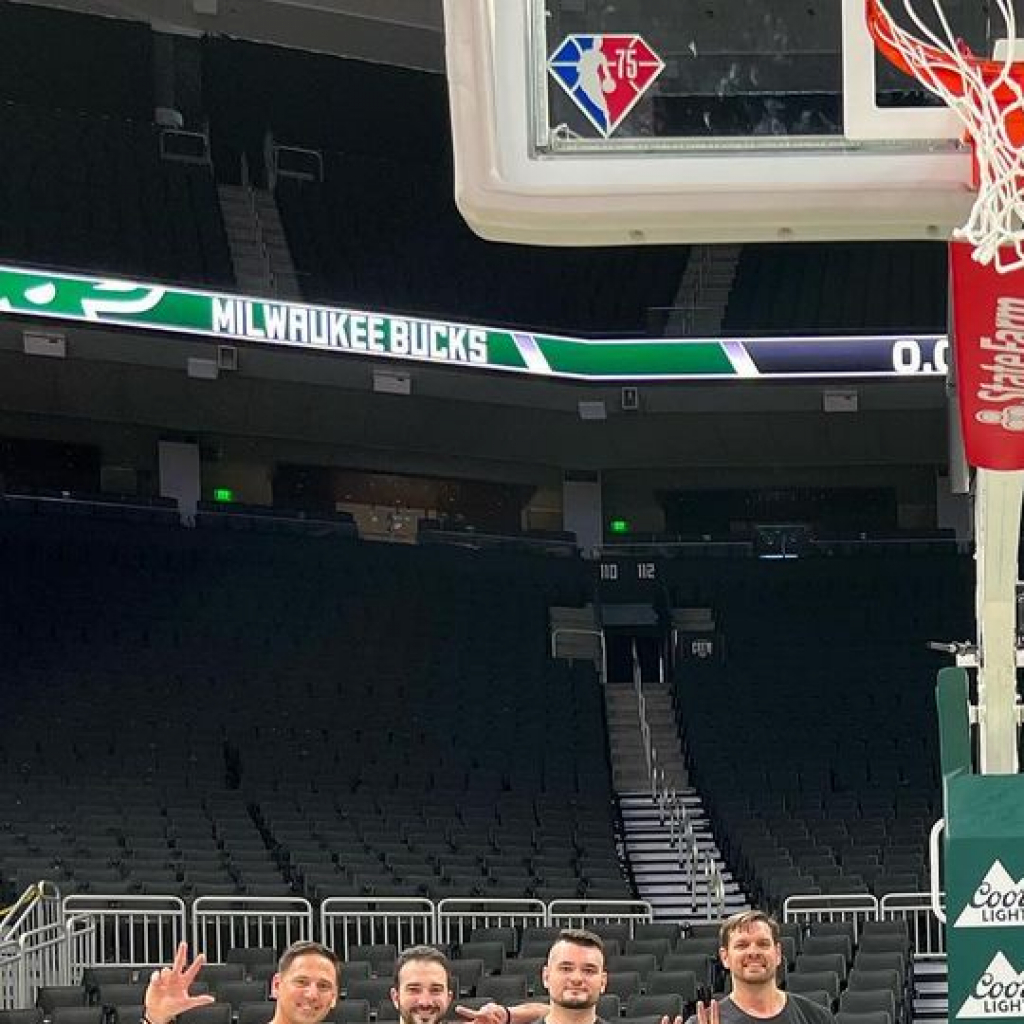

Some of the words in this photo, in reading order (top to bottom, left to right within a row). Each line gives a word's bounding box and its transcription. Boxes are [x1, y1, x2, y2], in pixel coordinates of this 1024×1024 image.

[615, 48, 638, 80] 75
[211, 297, 385, 353] MILWAUKEE
[389, 318, 488, 363] BUCKS
